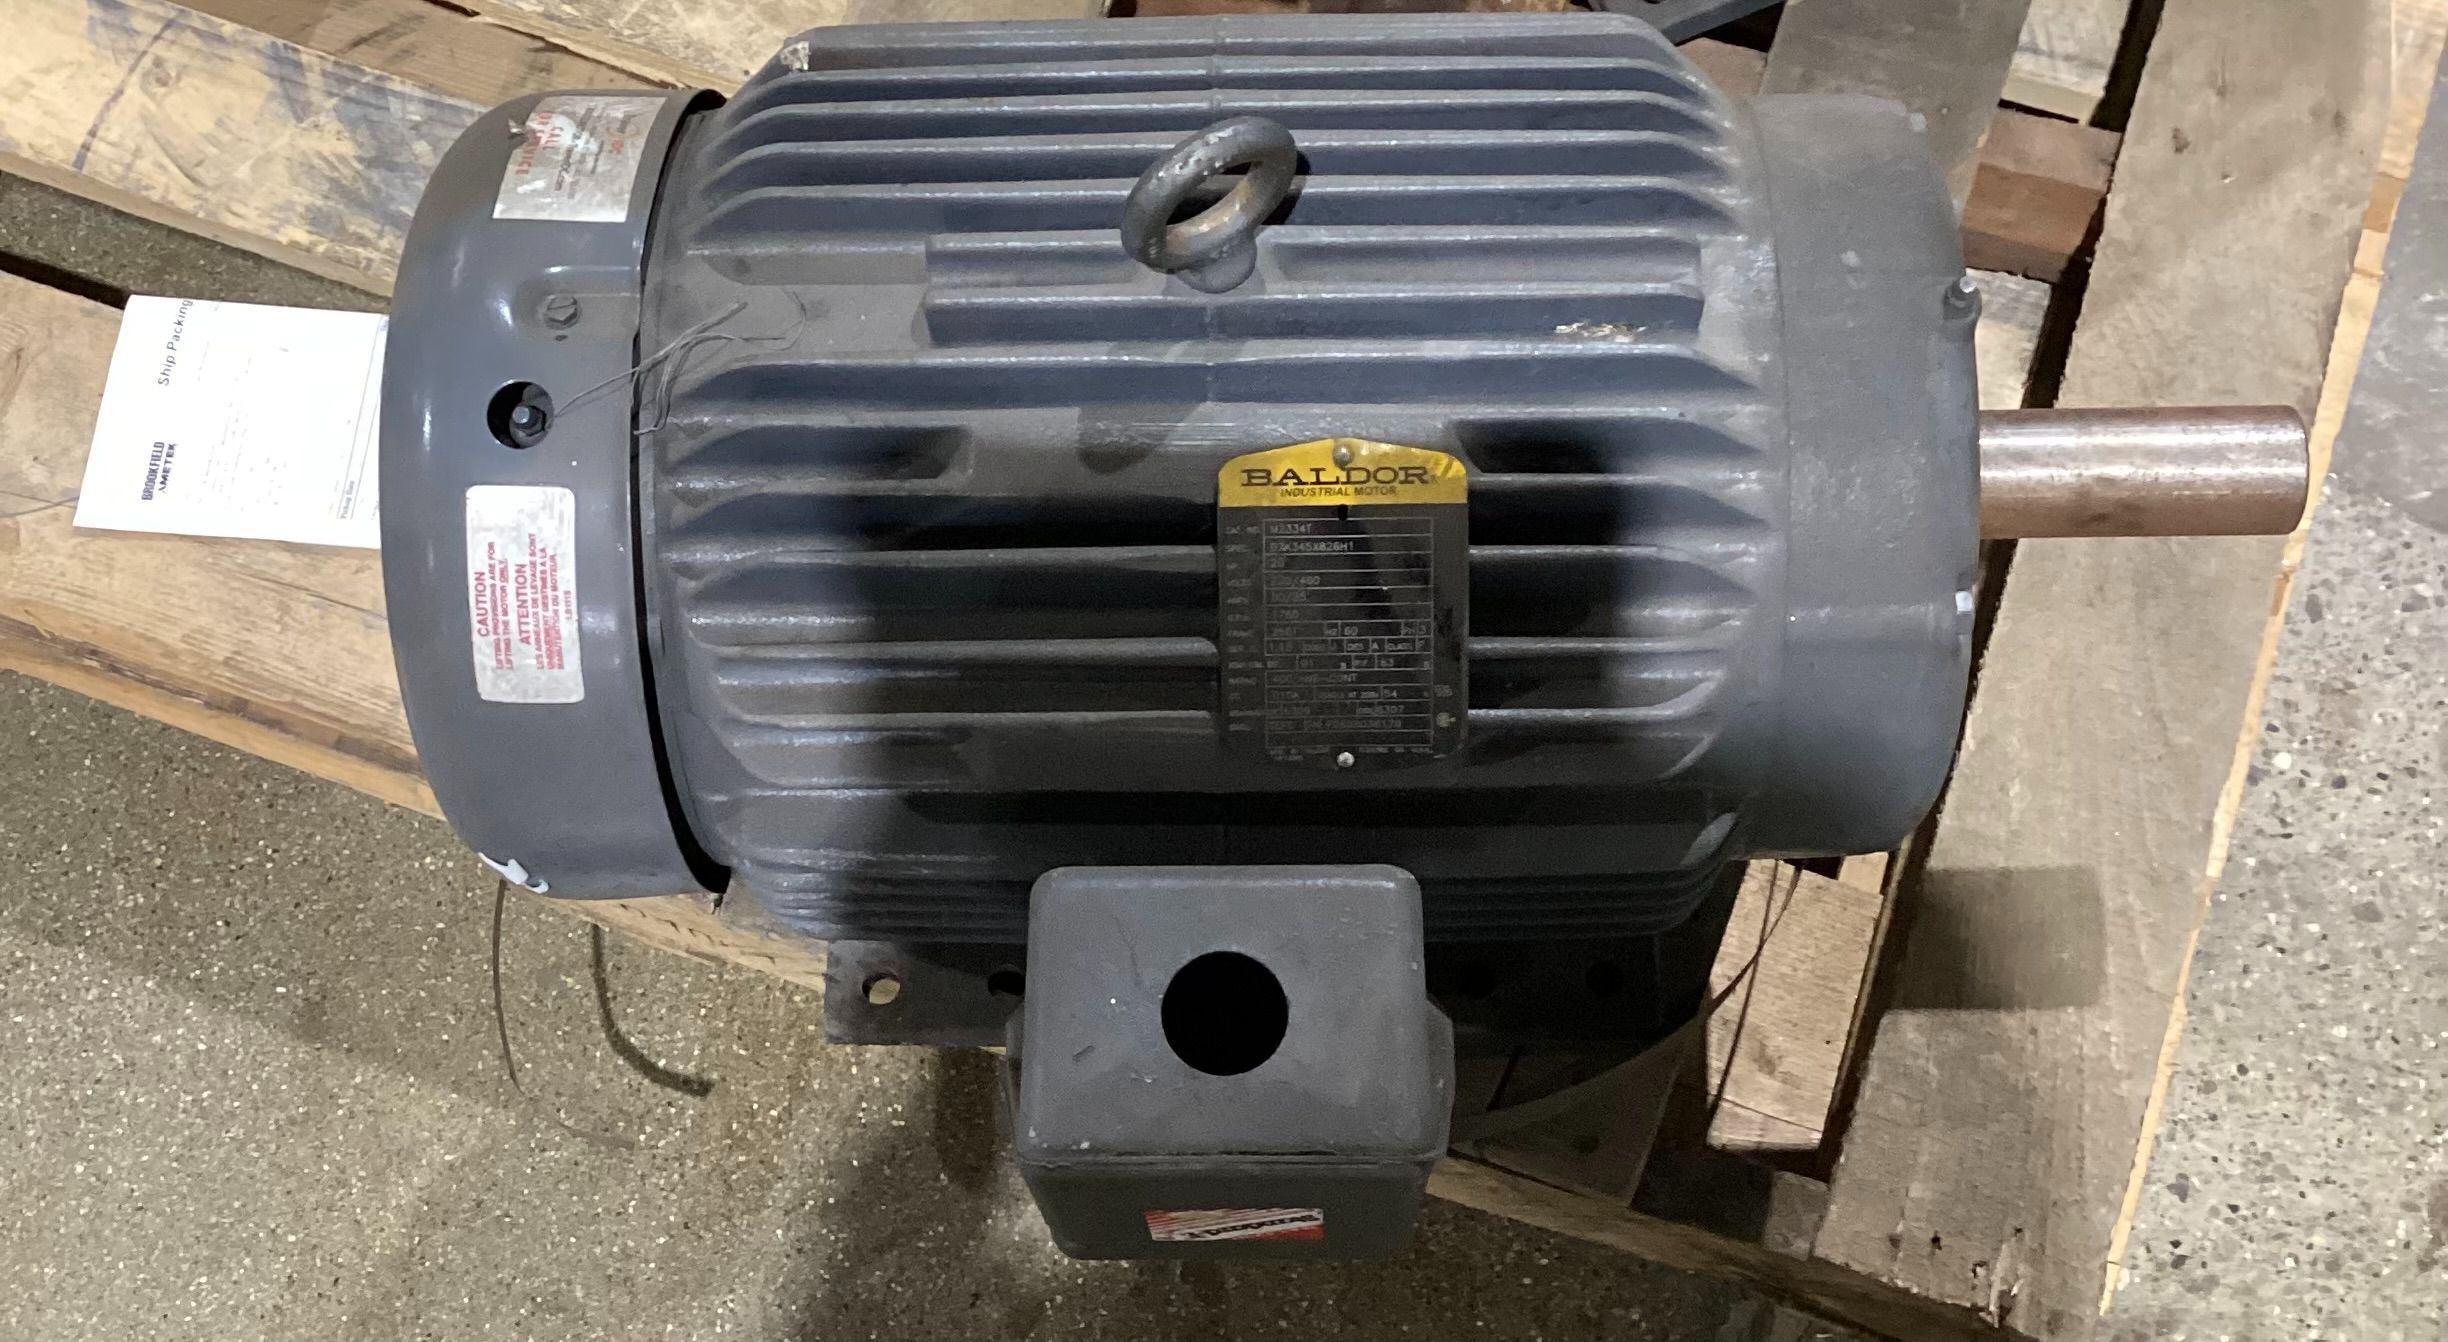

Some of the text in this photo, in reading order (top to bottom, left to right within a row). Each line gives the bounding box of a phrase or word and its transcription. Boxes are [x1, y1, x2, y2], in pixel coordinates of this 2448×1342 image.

[157, 298, 194, 386] Ship Packing
[141, 441, 165, 501] BROOKFIELD
[158, 442, 176, 494] AMETEK
[1241, 467, 1429, 486] BALDOR
[1280, 486, 1397, 497] INDUSTRIAL MOTOR
[488, 542, 496, 560] FOR
[528, 533, 537, 557] SONT
[488, 563, 496, 581] ARE
[529, 559, 538, 595] LEVAGE
[550, 554, 559, 592] MOTEUR
[474, 571, 490, 637] CAUTION
[500, 585, 509, 617] MOTOR
[515, 563, 531, 645] ATTENTION
[531, 597, 539, 609] DE
[552, 594, 559, 607] DU
[502, 620, 511, 635] THE
